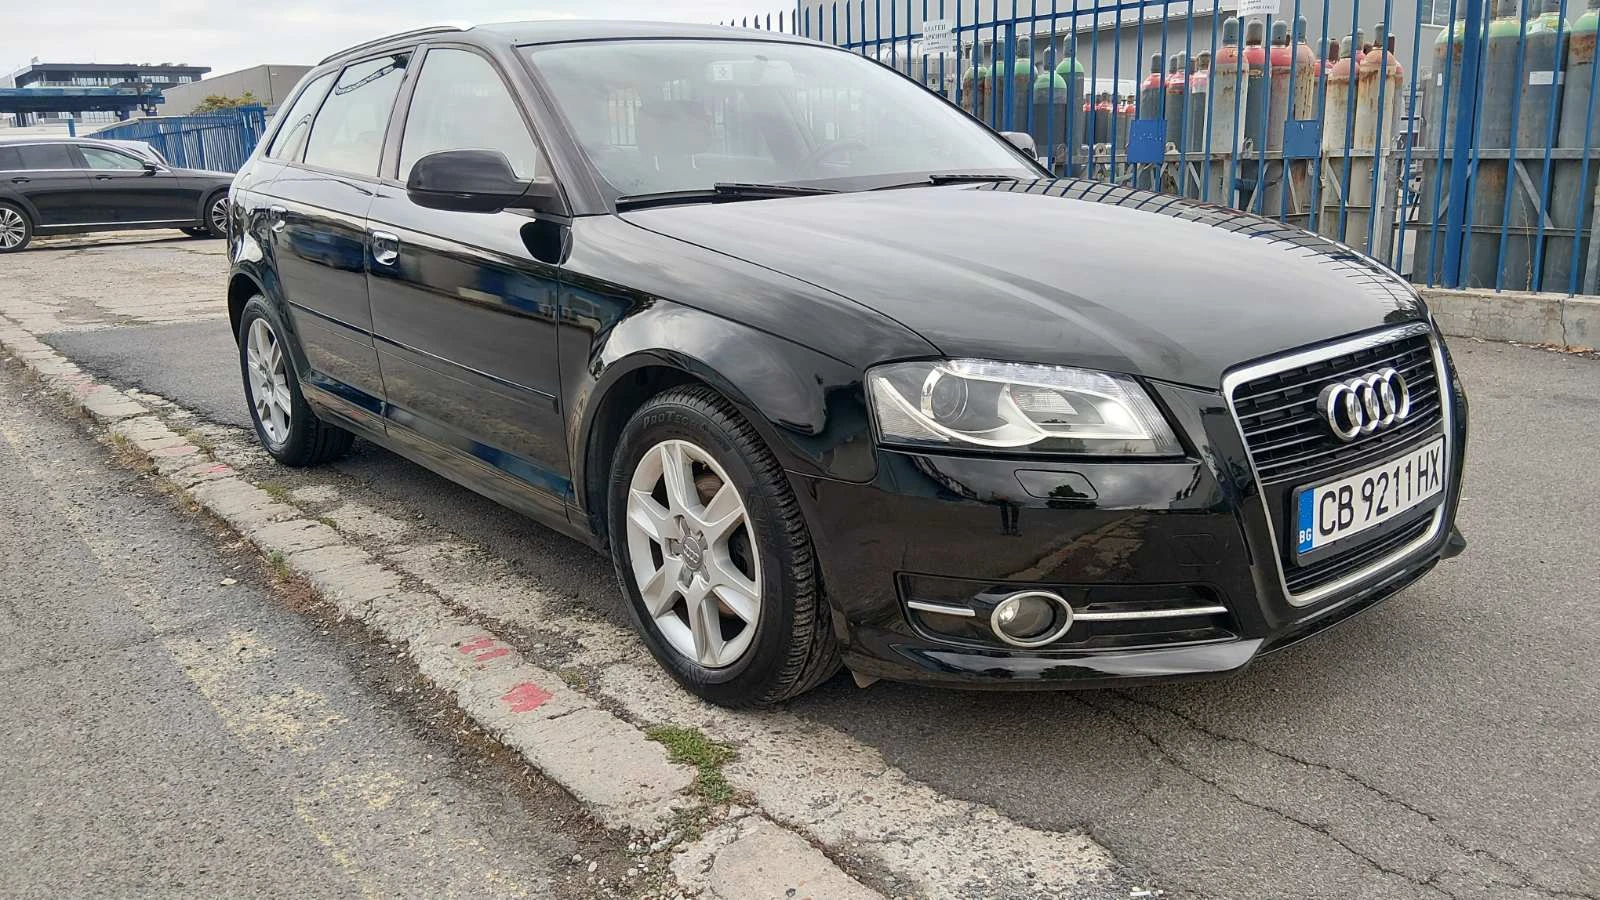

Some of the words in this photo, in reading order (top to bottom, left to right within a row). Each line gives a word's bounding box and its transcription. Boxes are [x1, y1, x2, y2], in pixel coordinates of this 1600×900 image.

[1318, 484, 1355, 537] CB
[1361, 459, 1412, 522] 9211
[1416, 446, 1441, 497] HX
[1298, 527, 1312, 544] BG
